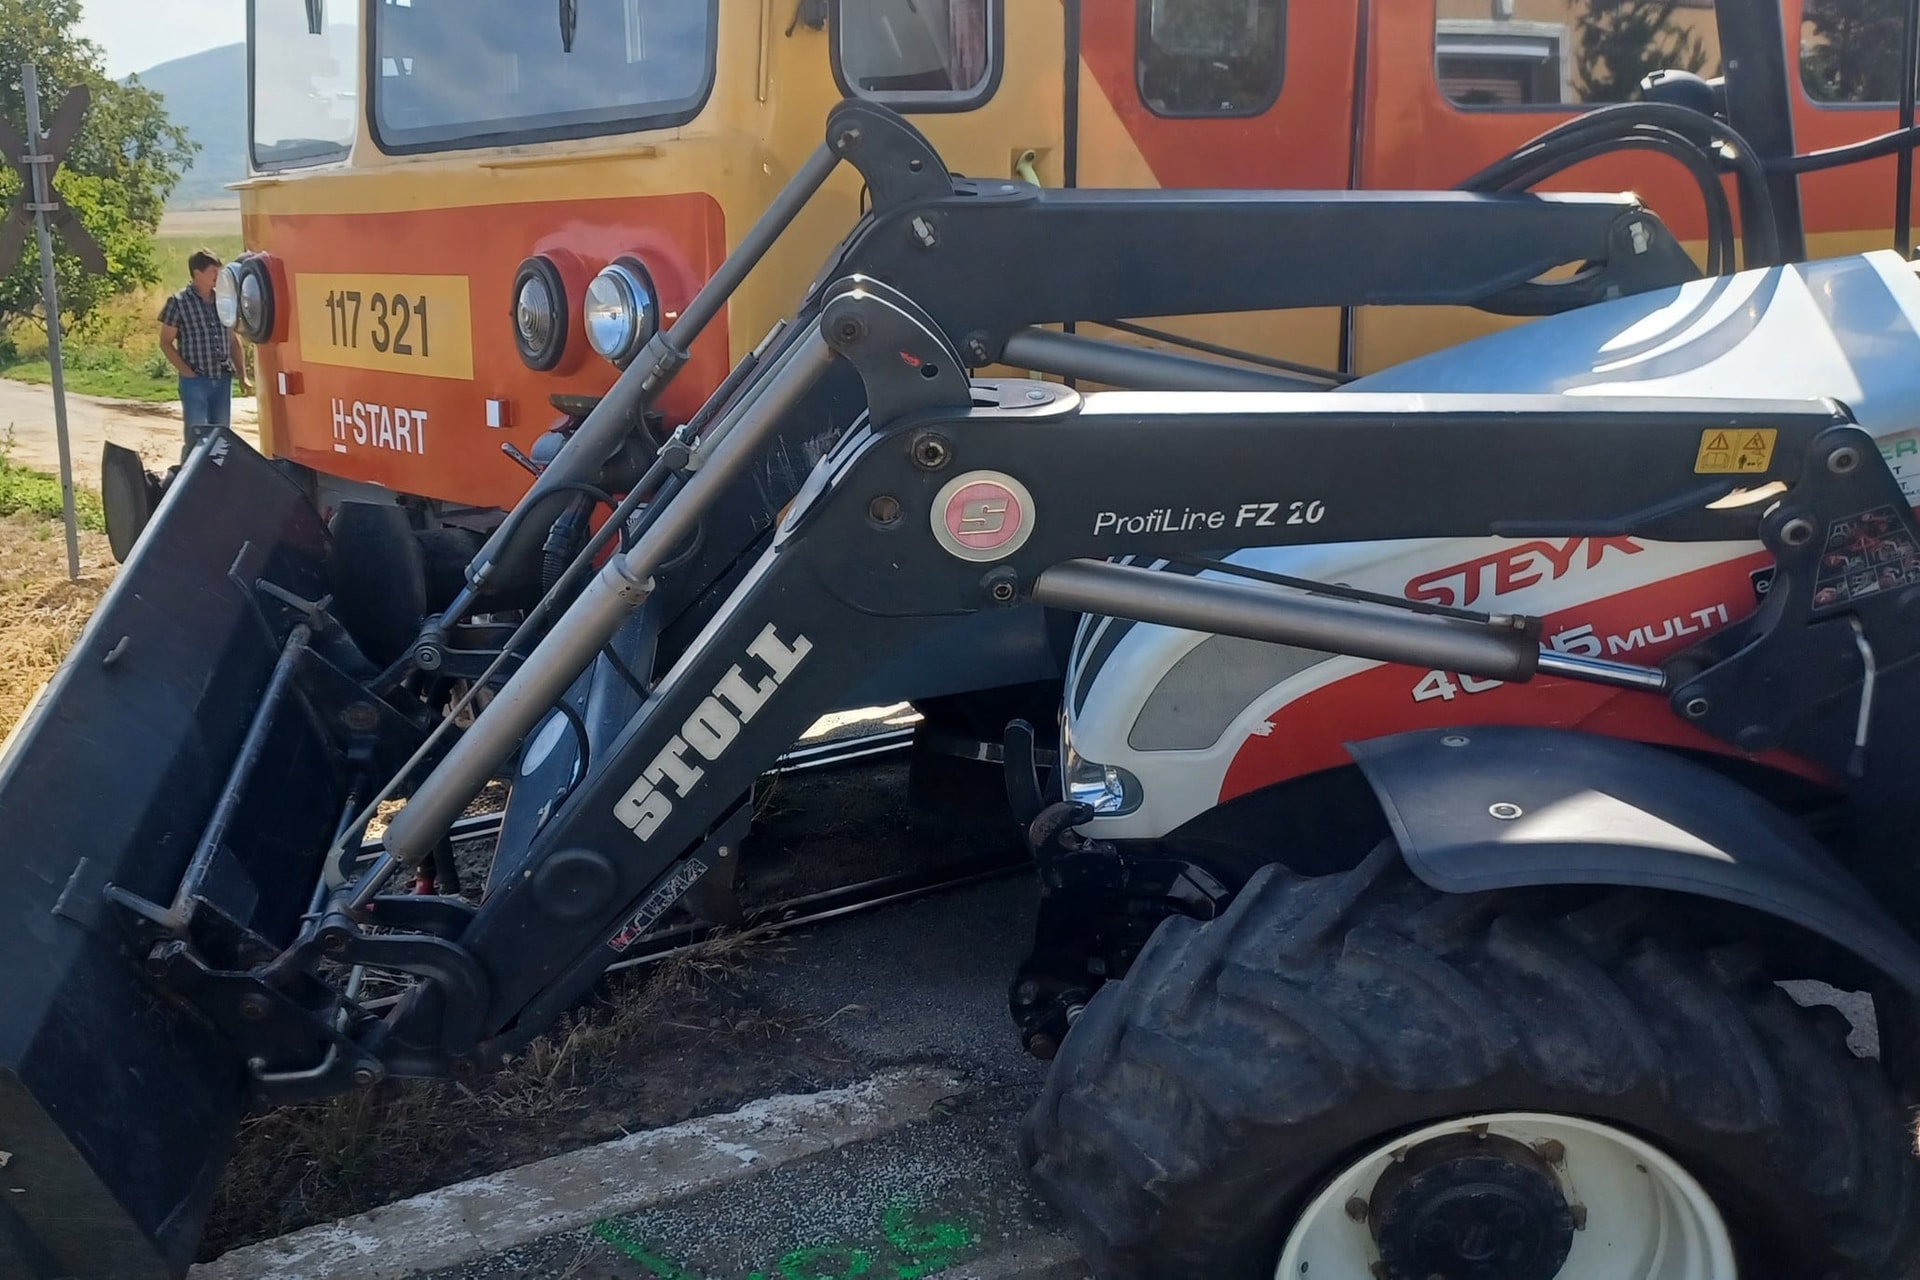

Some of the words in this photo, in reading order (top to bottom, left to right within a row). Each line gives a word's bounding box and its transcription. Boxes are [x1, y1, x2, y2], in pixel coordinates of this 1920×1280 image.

[325, 290, 361, 348] 117
[370, 292, 428, 357] 321
[332, 398, 427, 455] H-START
[1093, 507, 1225, 536] ProfiLine
[1235, 502, 1279, 528] FZ
[1286, 500, 1325, 525] 20
[1412, 624, 1602, 702] 45
[1606, 603, 1729, 656] MULTI
[612, 621, 814, 842] STOLL
